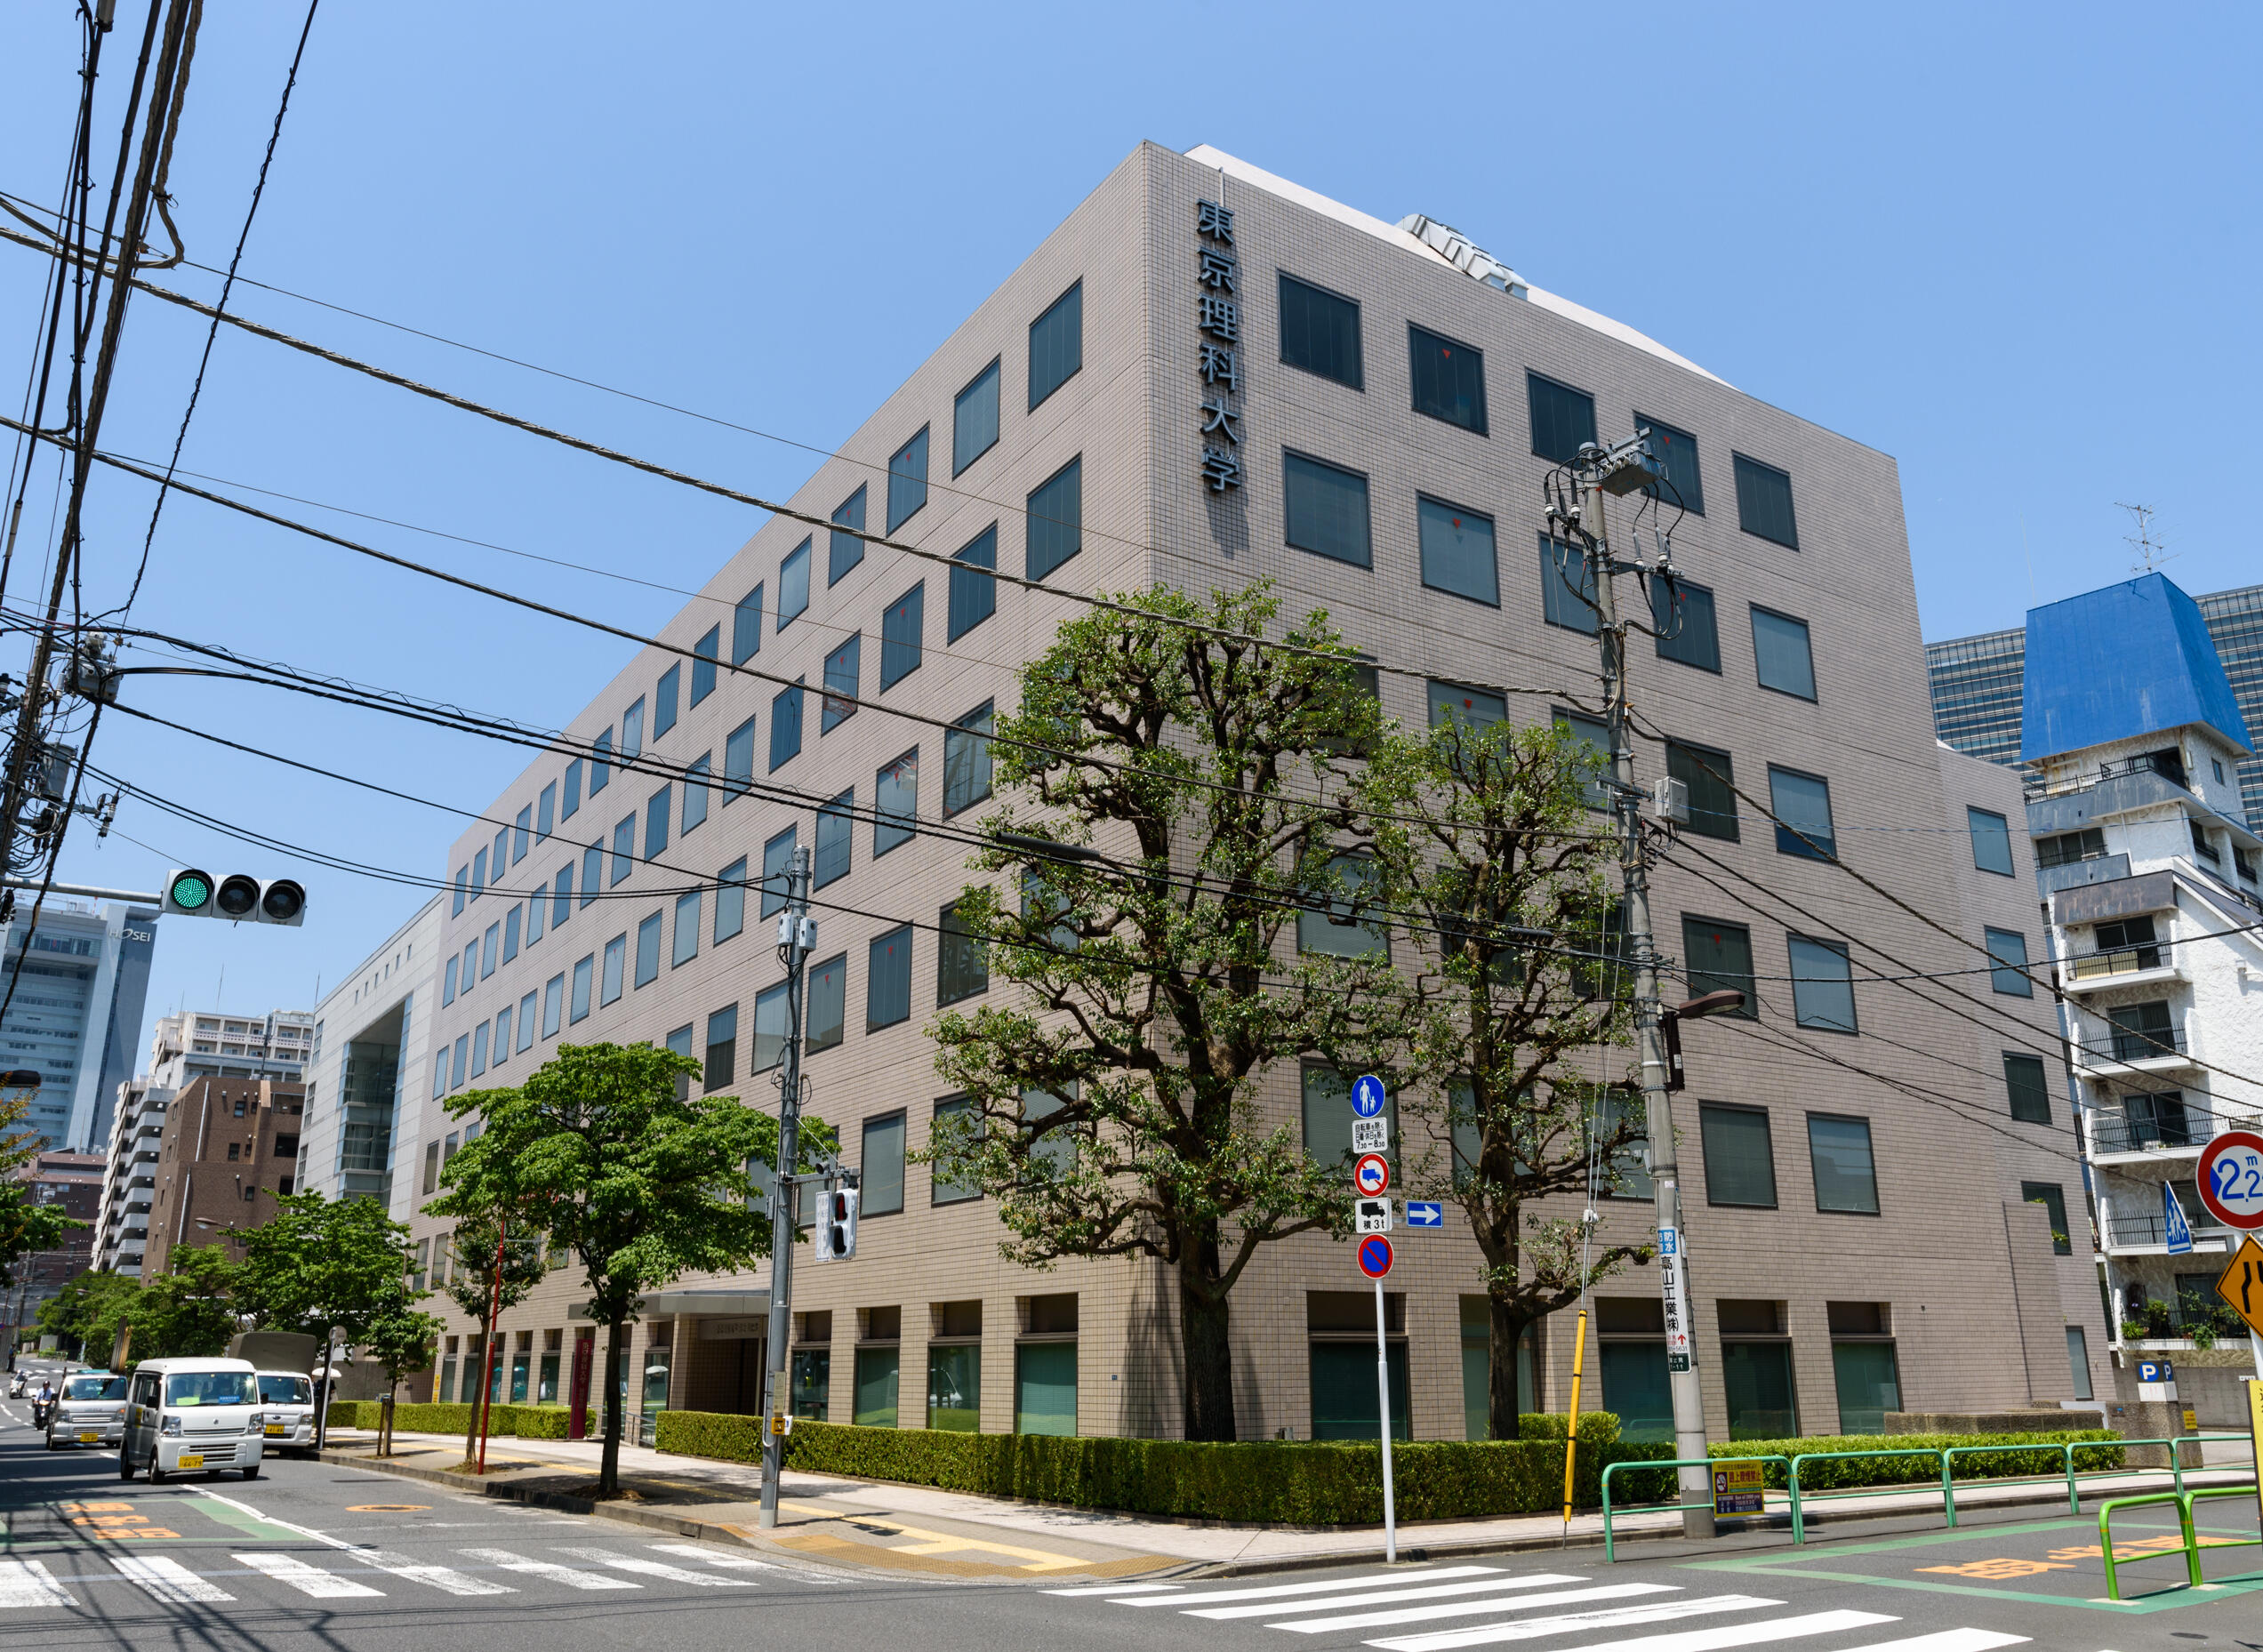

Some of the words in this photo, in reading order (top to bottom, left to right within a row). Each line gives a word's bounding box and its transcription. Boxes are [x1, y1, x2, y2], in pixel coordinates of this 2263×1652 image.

[1196, 197, 1241, 492] 東京理科大学
[108, 927, 151, 942] HOSEI
[2142, 1364, 2156, 1380] P
